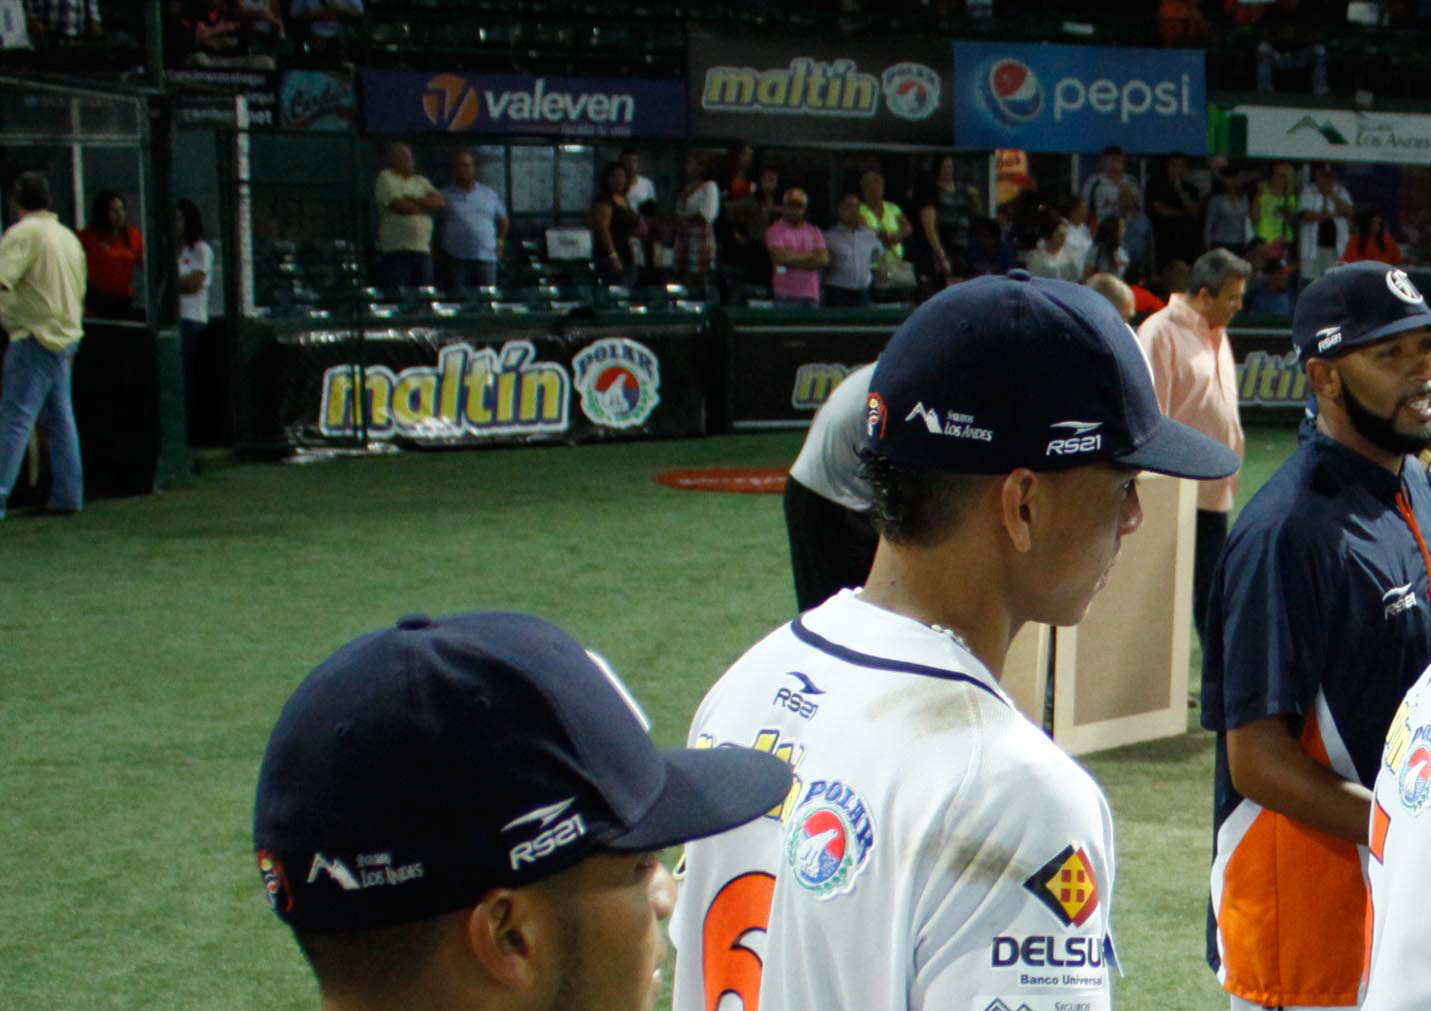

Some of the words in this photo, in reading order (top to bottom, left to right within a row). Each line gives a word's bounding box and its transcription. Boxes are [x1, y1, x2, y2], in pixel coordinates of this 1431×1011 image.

[484, 78, 635, 121] valeven
[703, 58, 873, 109] maltín
[1054, 74, 1191, 123] pepsi
[324, 343, 567, 432] maltín
[1046, 434, 1102, 456] RS21
[509, 813, 586, 870] RS21
[802, 780, 874, 864] POLAR
[1020, 974, 1059, 986] Banco
